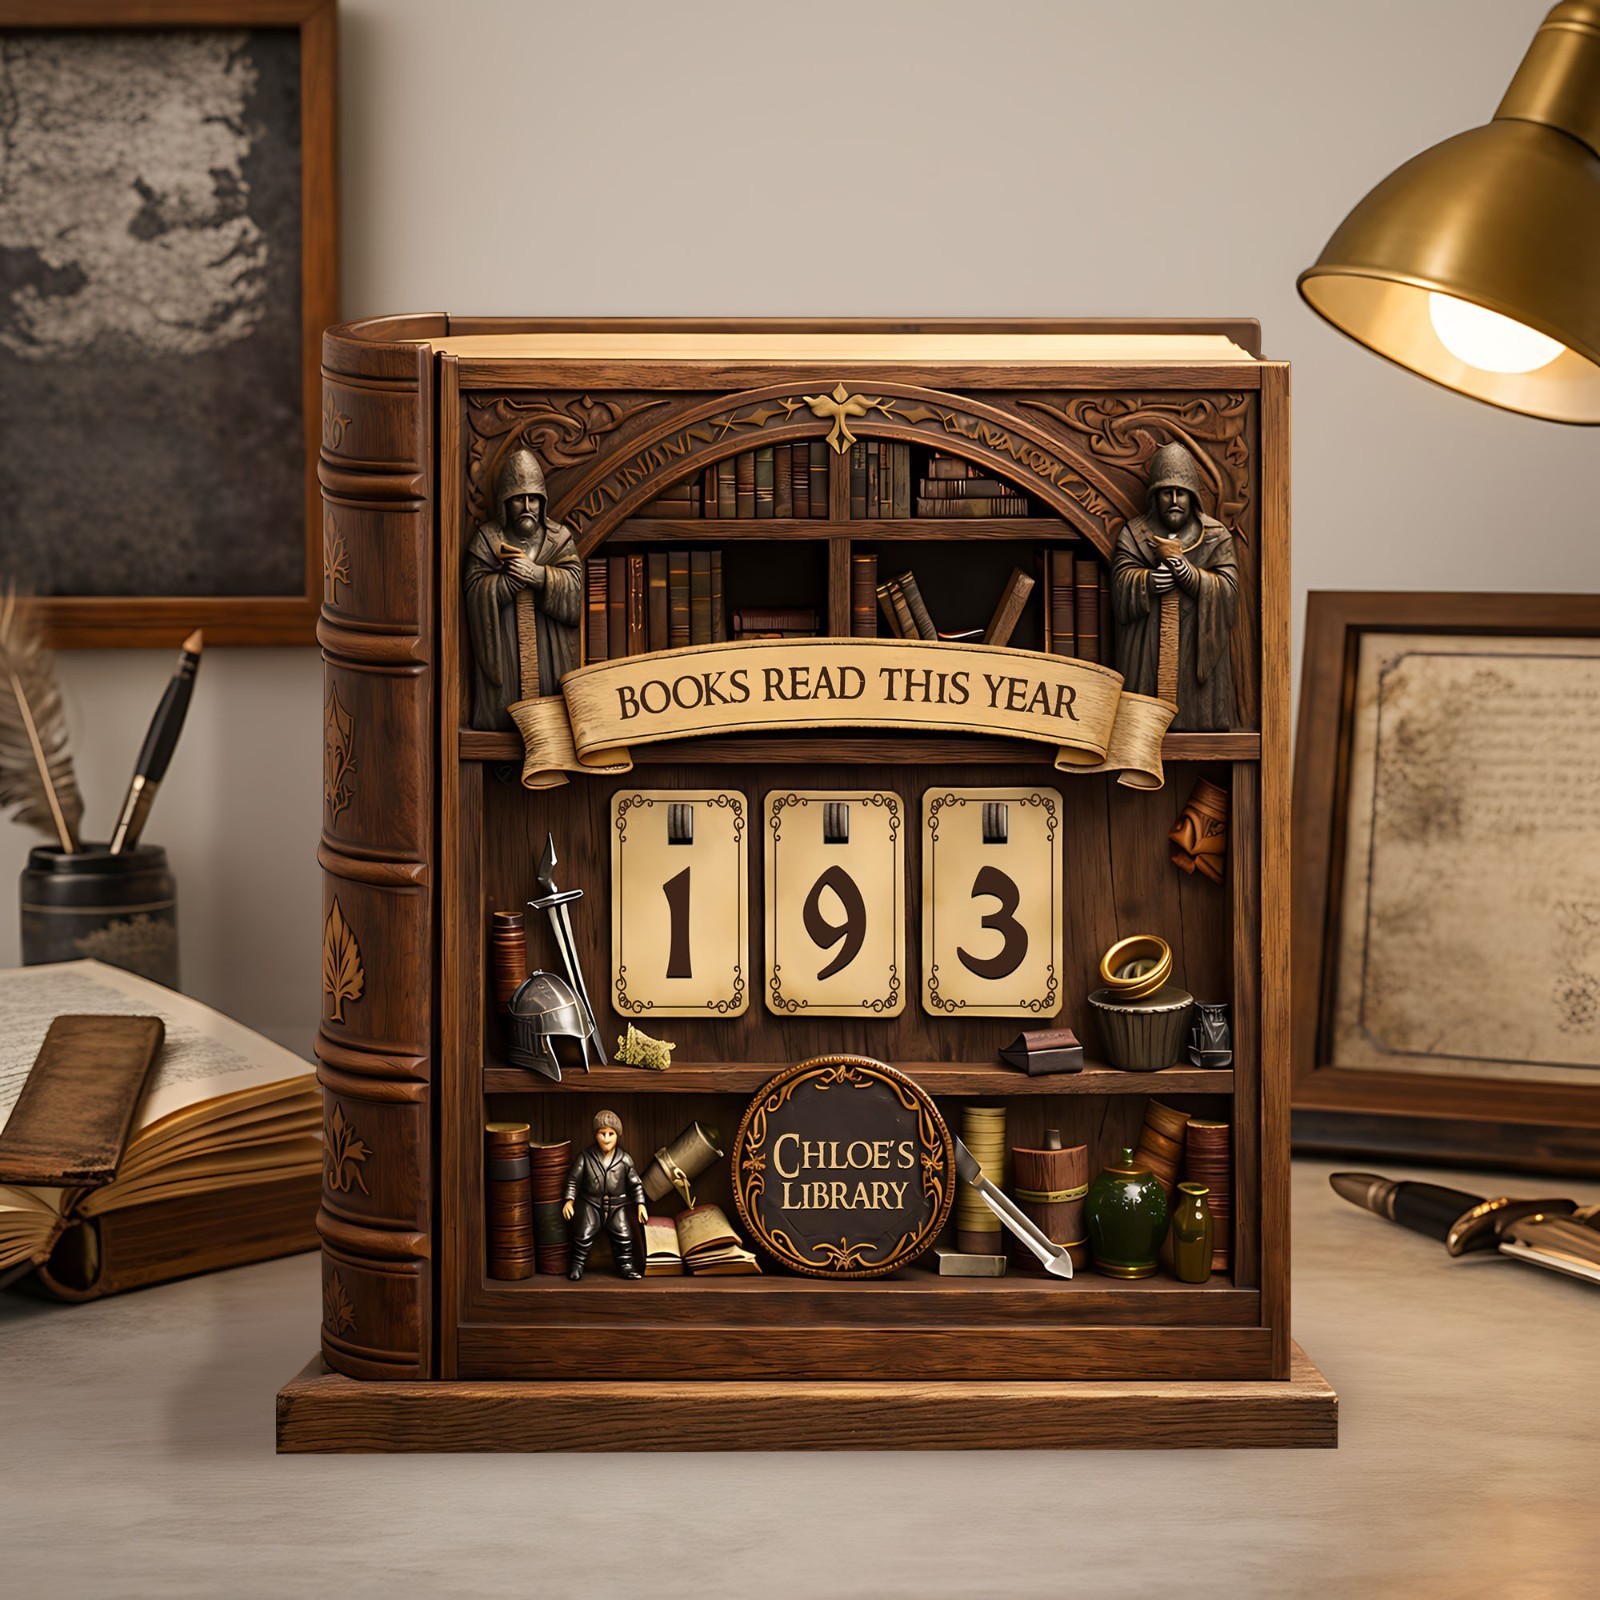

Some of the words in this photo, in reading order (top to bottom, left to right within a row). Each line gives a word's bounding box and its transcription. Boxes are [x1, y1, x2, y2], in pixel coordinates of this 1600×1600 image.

[615, 669, 751, 721] BOOKS
[763, 666, 866, 703] READ
[879, 667, 971, 706] THIS
[986, 675, 1080, 721] YEAR
[773, 1133, 915, 1179] CHLOE'S
[781, 1181, 910, 1210] LIBRARY
